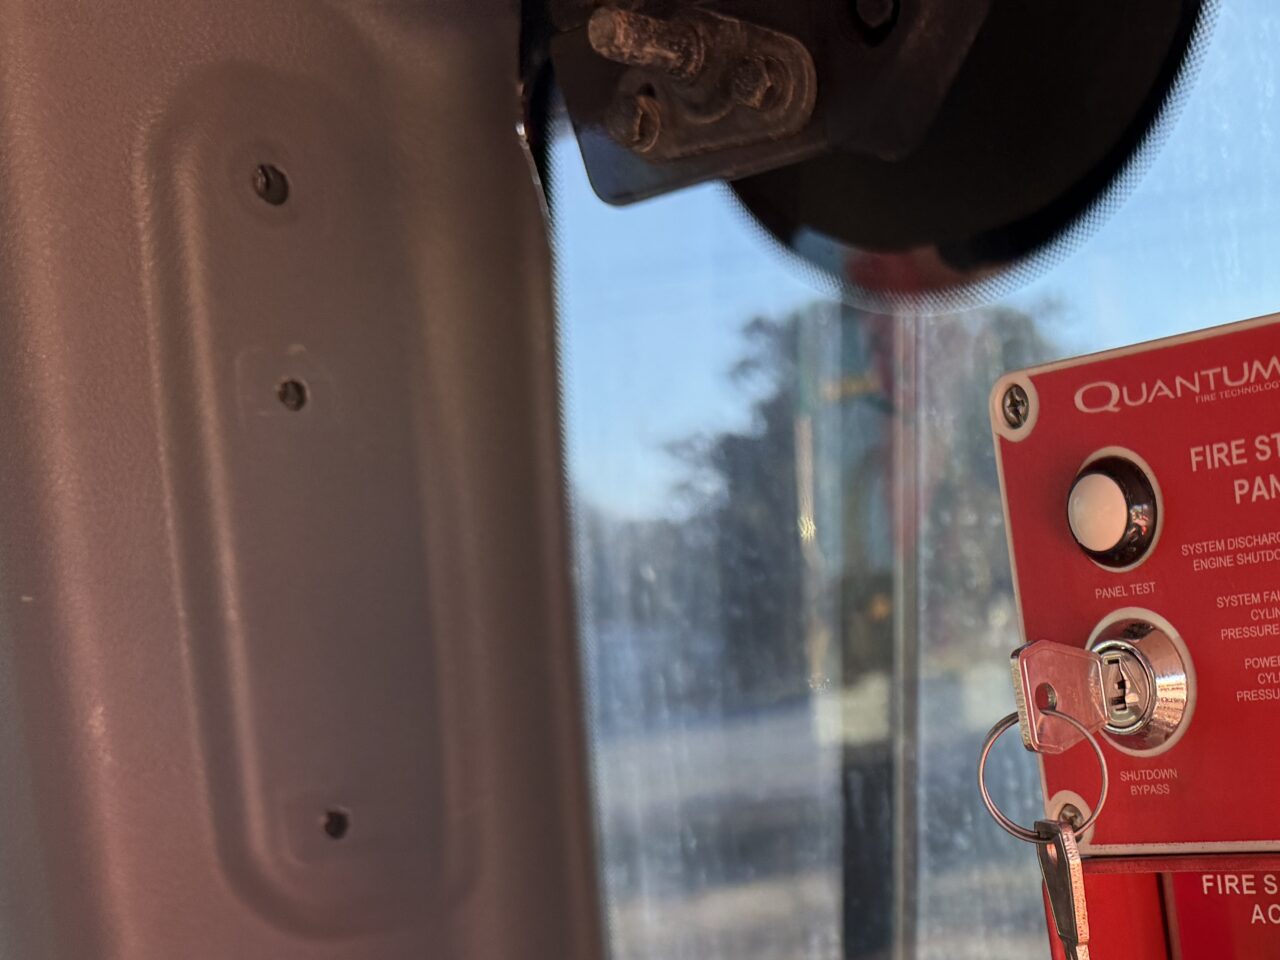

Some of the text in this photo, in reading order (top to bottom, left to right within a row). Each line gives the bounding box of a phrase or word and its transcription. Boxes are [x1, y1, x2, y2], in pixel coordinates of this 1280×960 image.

[1195, 390, 1217, 404] FIRE
[1190, 438, 1248, 472] FIRE
[1181, 539, 1225, 557] SYSTEM
[1193, 556, 1235, 572] ENGINE
[1095, 581, 1156, 599] PANEL TEST
[1216, 592, 1261, 609] SYSTEM
[1221, 623, 1280, 641] PRESSURE
[1120, 768, 1178, 782] SHUTDOWN
[1130, 783, 1170, 796] BYPASS
[1202, 874, 1256, 896] FIRE
